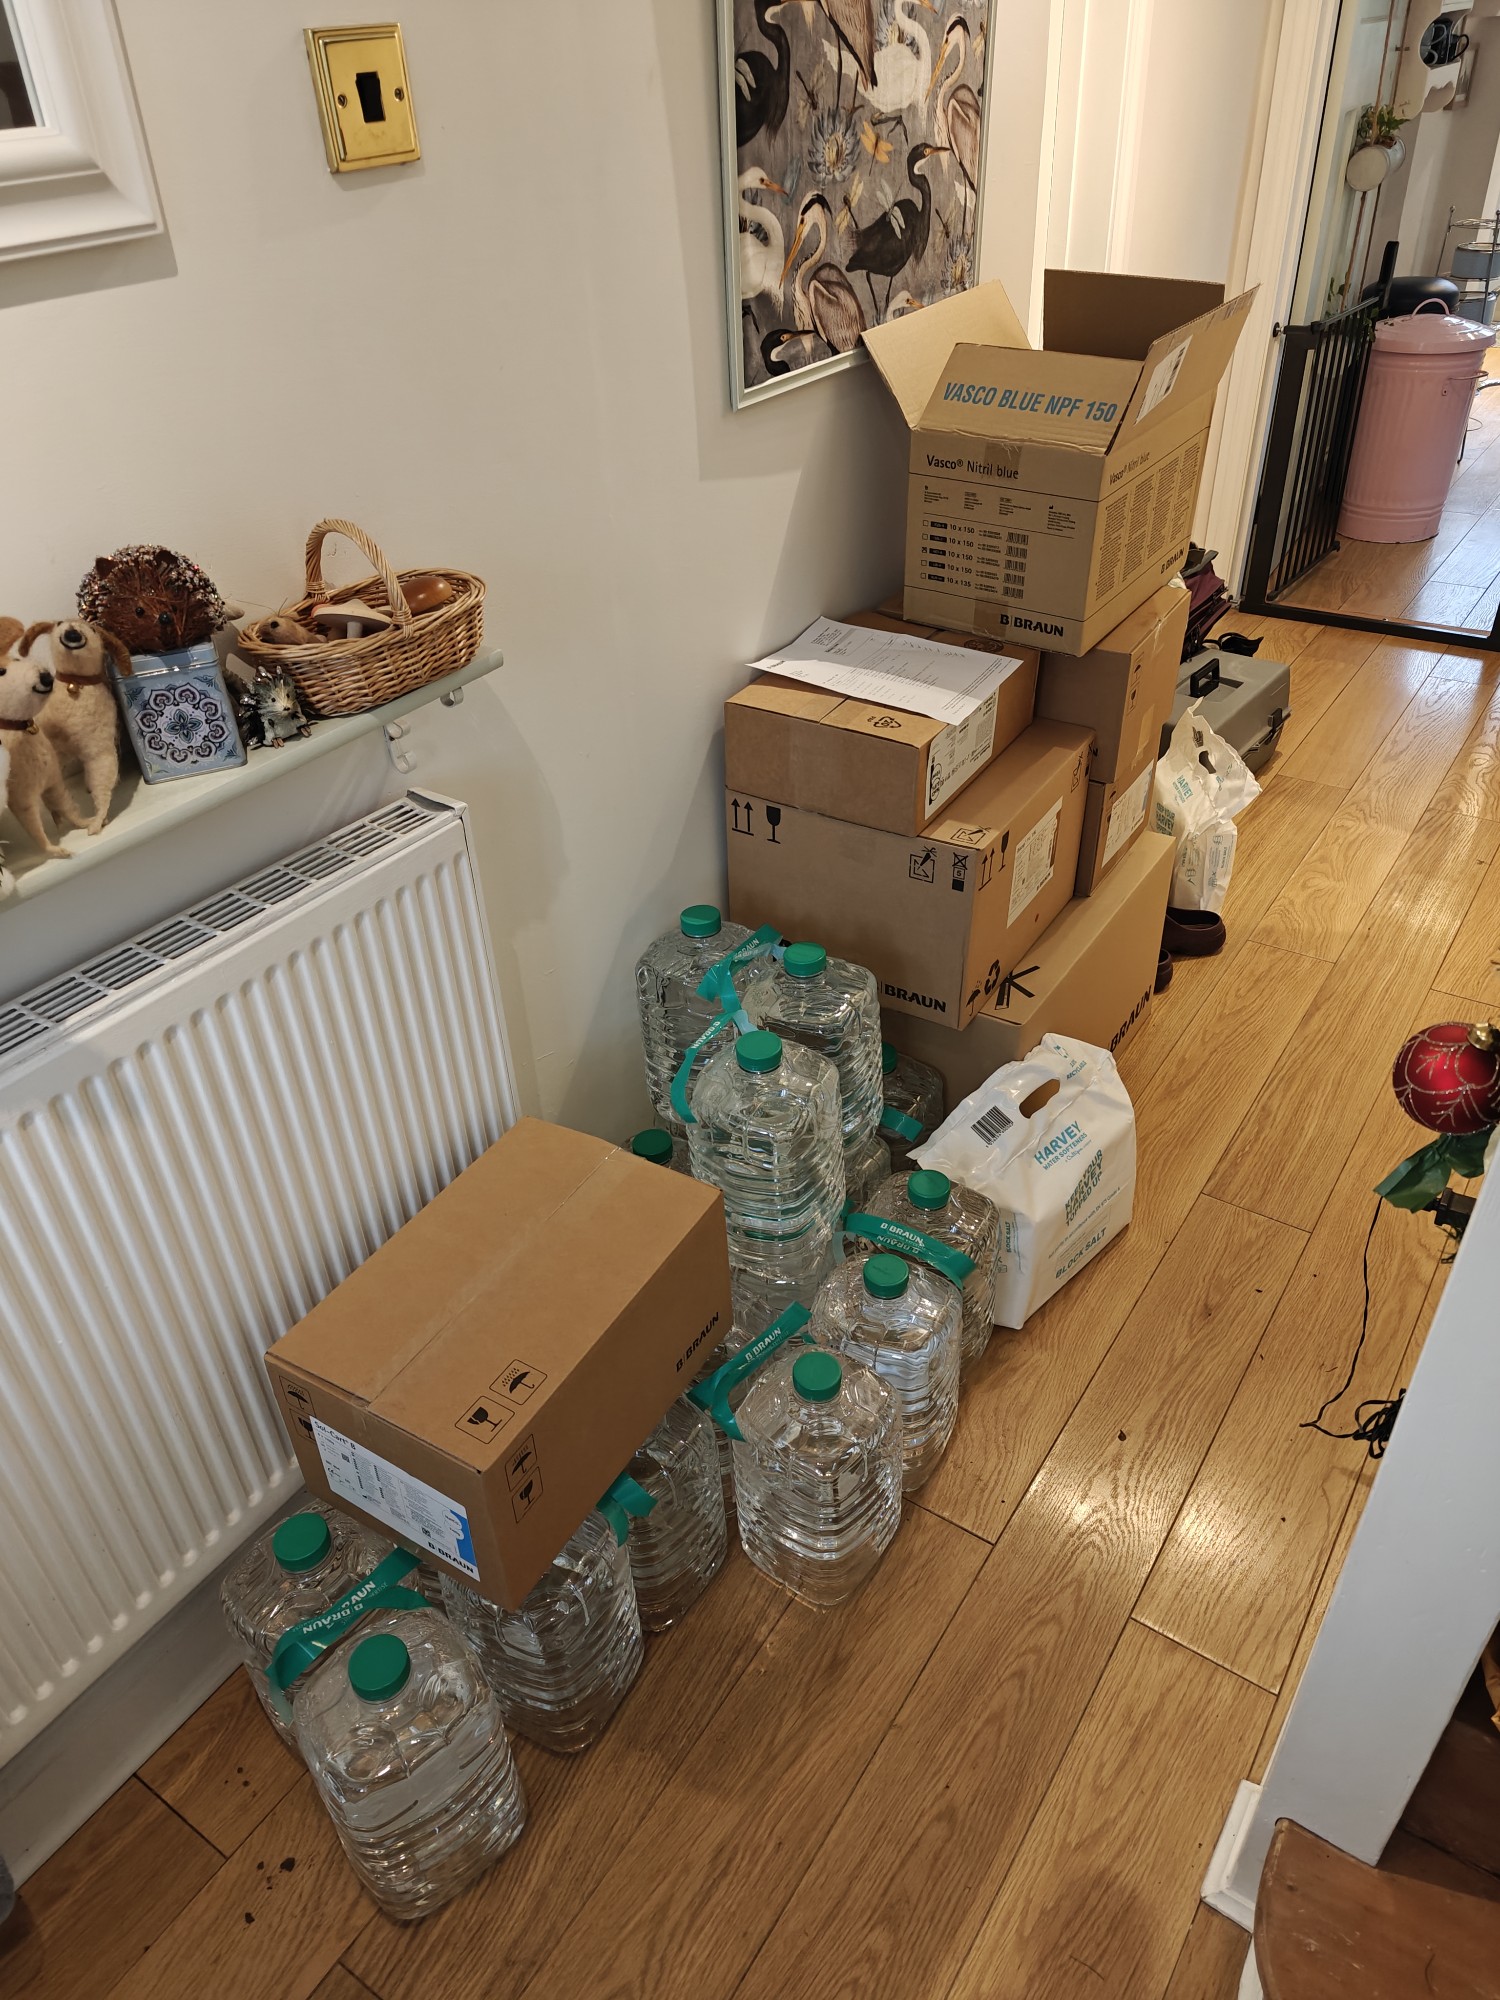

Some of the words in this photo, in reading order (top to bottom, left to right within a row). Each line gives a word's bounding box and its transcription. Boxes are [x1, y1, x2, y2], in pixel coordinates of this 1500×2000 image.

[944, 382, 997, 406] VASCO
[997, 389, 1044, 413] BLUE
[1044, 394, 1083, 418] NPF
[1084, 400, 1118, 423] 150
[967, 460, 992, 476] Nitril
[996, 465, 1019, 480] blue
[949, 523, 957, 531] 10
[964, 526, 975, 534] 150
[948, 550, 955, 558] 10
[962, 553, 973, 561] 150
[963, 539, 974, 548] 150
[961, 566, 973, 575] 150
[1165, 547, 1185, 571] BRAUN
[961, 580, 972, 588] 135
[1000, 614, 1010, 626] B
[1013, 616, 1064, 637] BRAUN
[1177, 774, 1194, 800] HARVEY
[1156, 811, 1175, 831] HARVEY
[884, 983, 947, 1013] BRAUN
[1110, 985, 1152, 1053] BRAUN
[1034, 1120, 1082, 1165] HARVEY
[1042, 1155, 1061, 1171] WATER
[1059, 1133, 1087, 1158] SOFTENERS
[1065, 1179, 1083, 1211] KEEP
[1082, 1149, 1103, 1179] YOUR
[1066, 1158, 1103, 1219] HARVEY
[1066, 1187, 1092, 1227] TOPPED
[1092, 1171, 1102, 1188] UP
[889, 1225, 924, 1243] BRAUN
[1056, 1250, 1083, 1279] BLOCK
[1085, 1227, 1107, 1255] SALT
[676, 1358, 684, 1373] B
[685, 1311, 719, 1361] BRAUN
[753, 1327, 782, 1355] BRAUN
[428, 1541, 436, 1550] B
[438, 1548, 474, 1574] BRAUN
[302, 1609, 351, 1634] BRAUN
